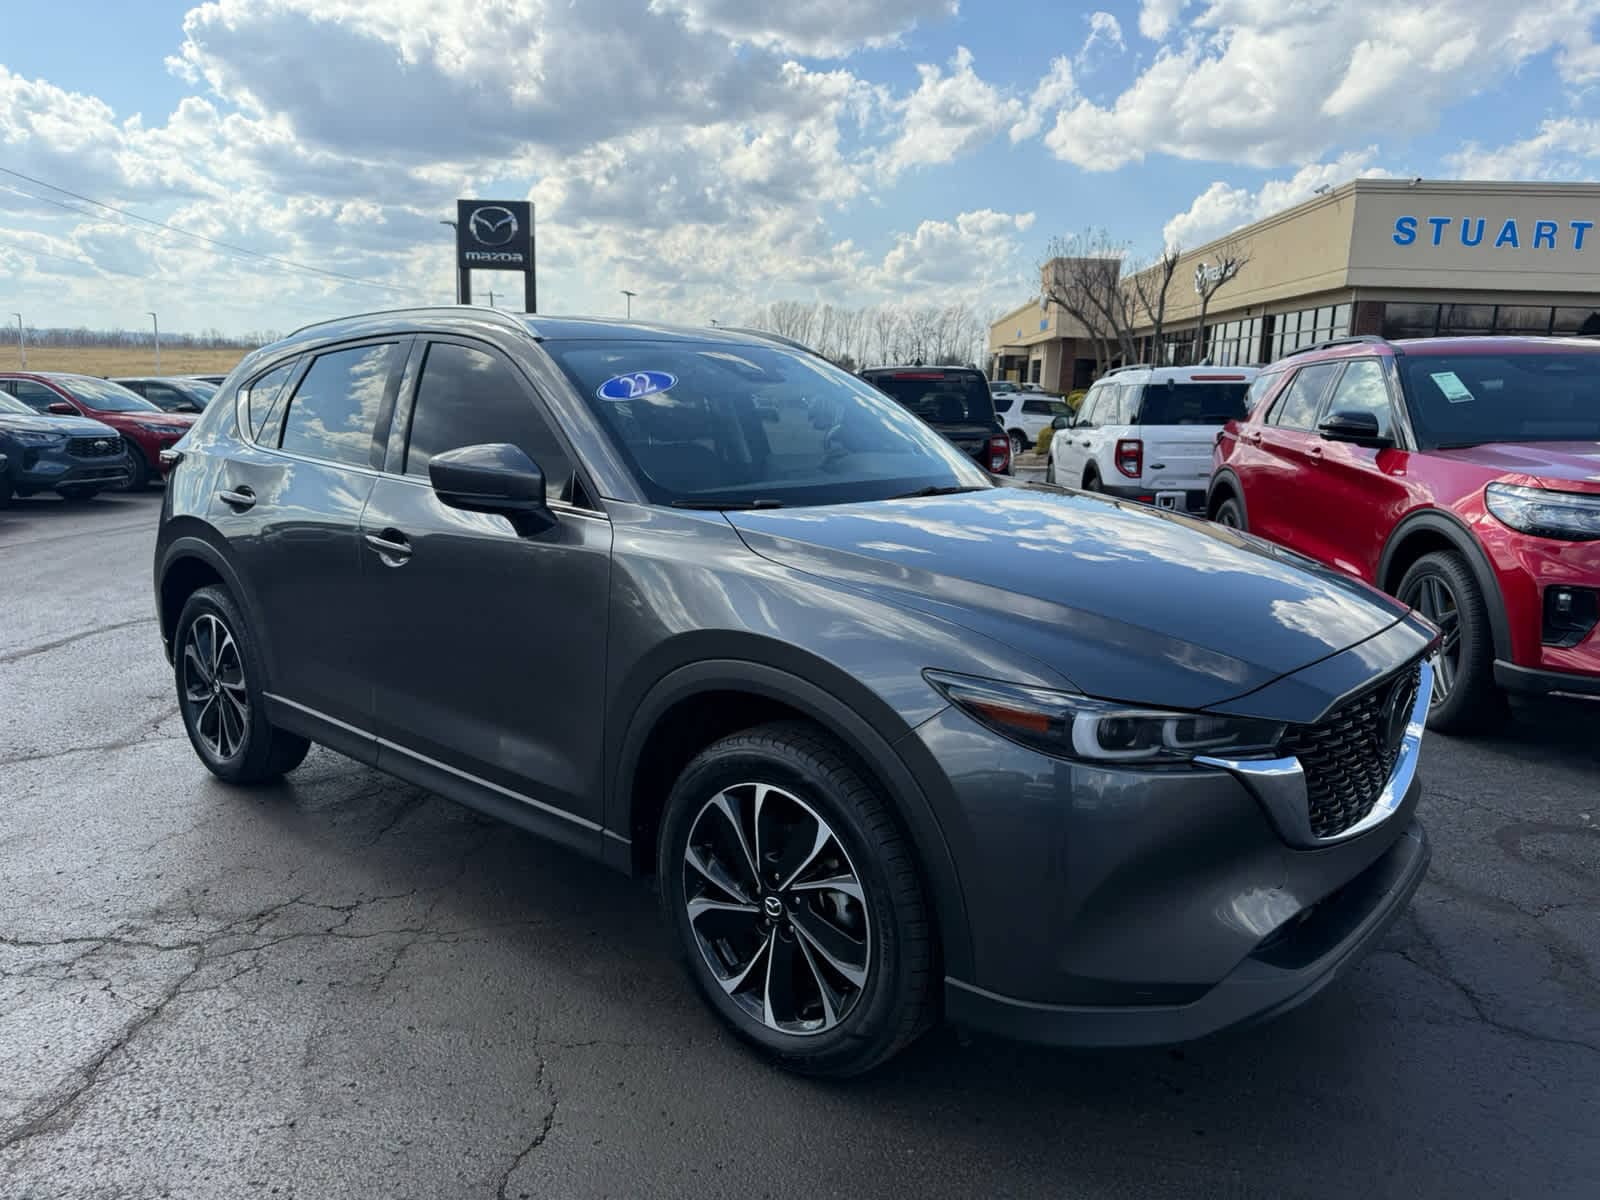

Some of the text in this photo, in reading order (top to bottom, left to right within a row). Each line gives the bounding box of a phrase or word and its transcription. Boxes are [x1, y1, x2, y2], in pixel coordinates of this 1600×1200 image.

[1392, 216, 1594, 251] STUART
[465, 251, 523, 262] mazda
[620, 373, 657, 397] 22
